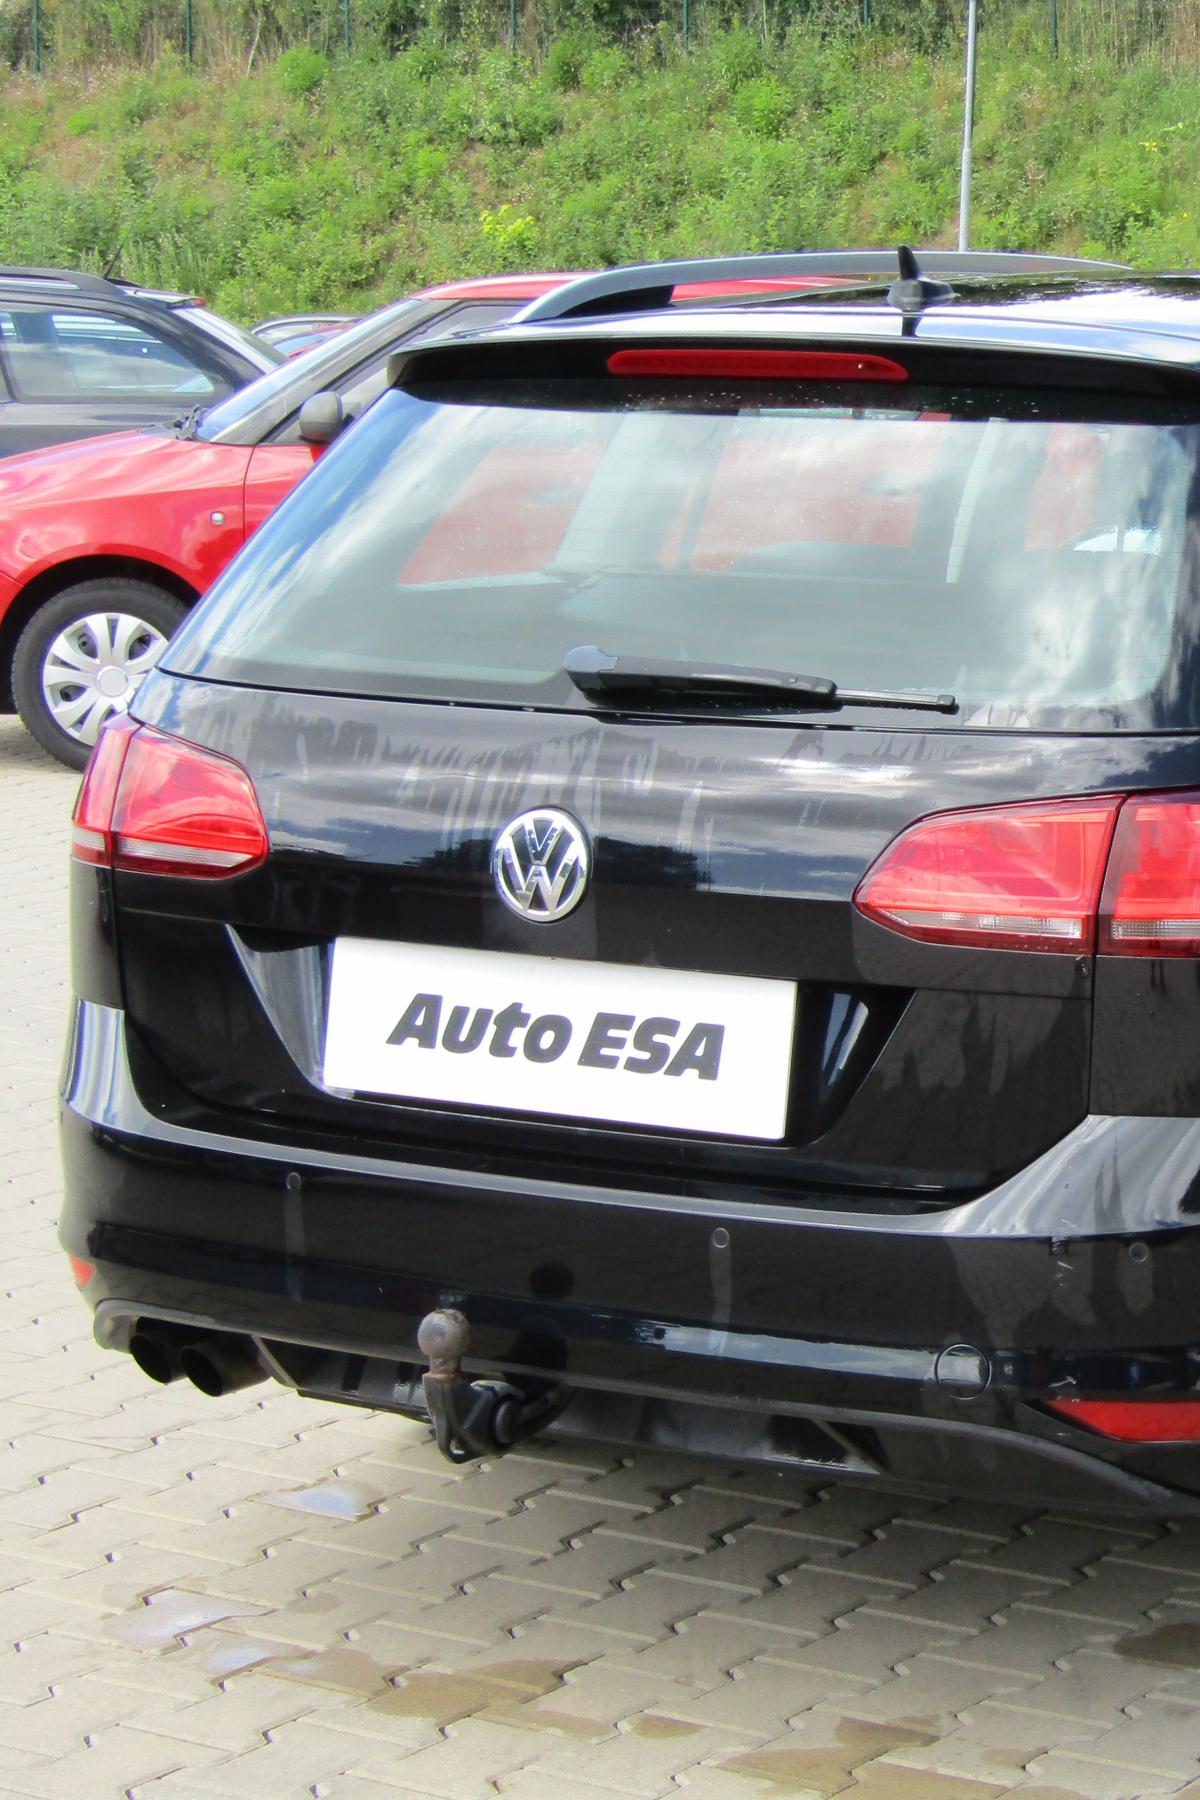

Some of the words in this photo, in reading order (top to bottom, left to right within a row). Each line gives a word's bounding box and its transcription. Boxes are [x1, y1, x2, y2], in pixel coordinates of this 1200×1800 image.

[495, 811, 588, 919] VW
[385, 993, 573, 1063] Auto
[577, 1012, 725, 1081] ESA
